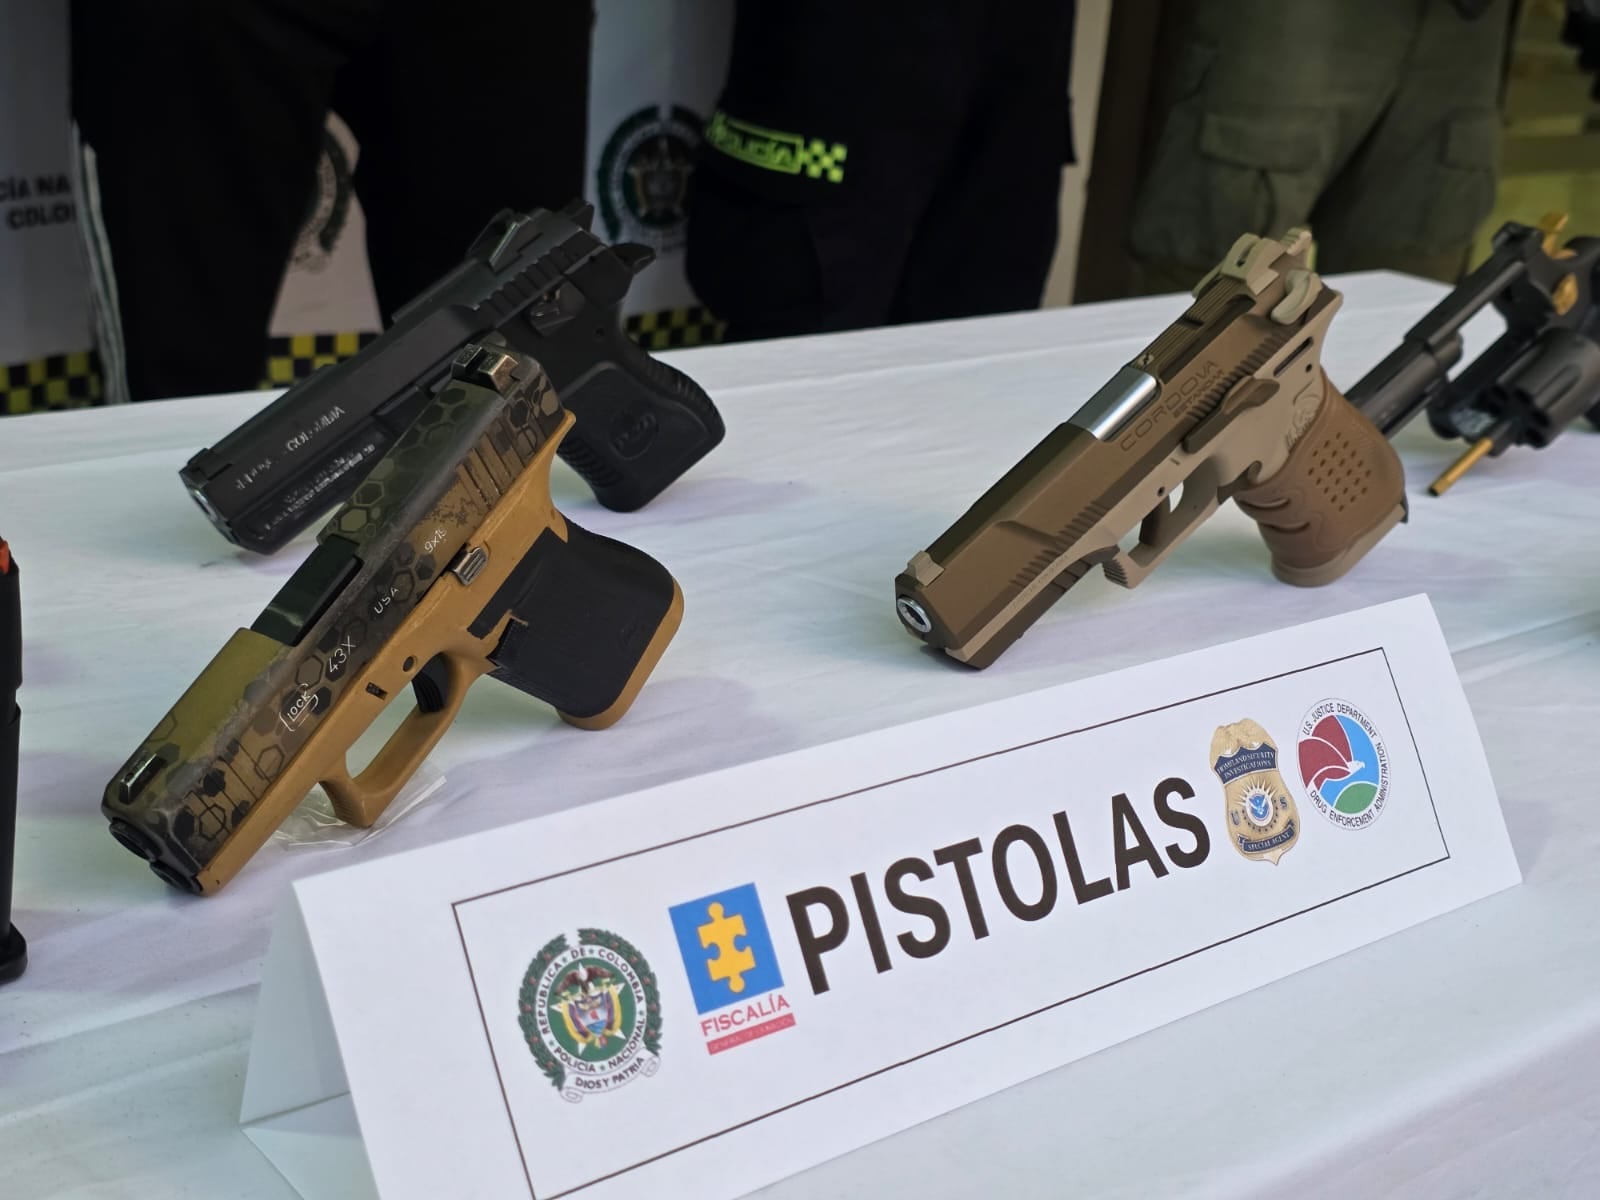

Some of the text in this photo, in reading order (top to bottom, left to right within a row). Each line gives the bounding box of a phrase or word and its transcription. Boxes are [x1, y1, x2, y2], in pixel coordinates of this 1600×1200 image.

[1121, 361, 1218, 451] CORDOVA
[374, 587, 399, 614] USA
[328, 635, 357, 673] 43X
[1312, 703, 1334, 722] JUSTICE
[1337, 704, 1376, 738] DEPARTMENT
[1309, 742, 1390, 828] DRUG ENFORCEMENT ADMINISTRATION
[786, 777, 1211, 995] PISTOLAS
[538, 948, 644, 1034] REPUBLICA DE COLOMBIA
[700, 994, 791, 1036] FISCALÍA
[553, 1017, 646, 1074] POLICIA NACIONAL
[611, 1056, 646, 1084] PATRIA
